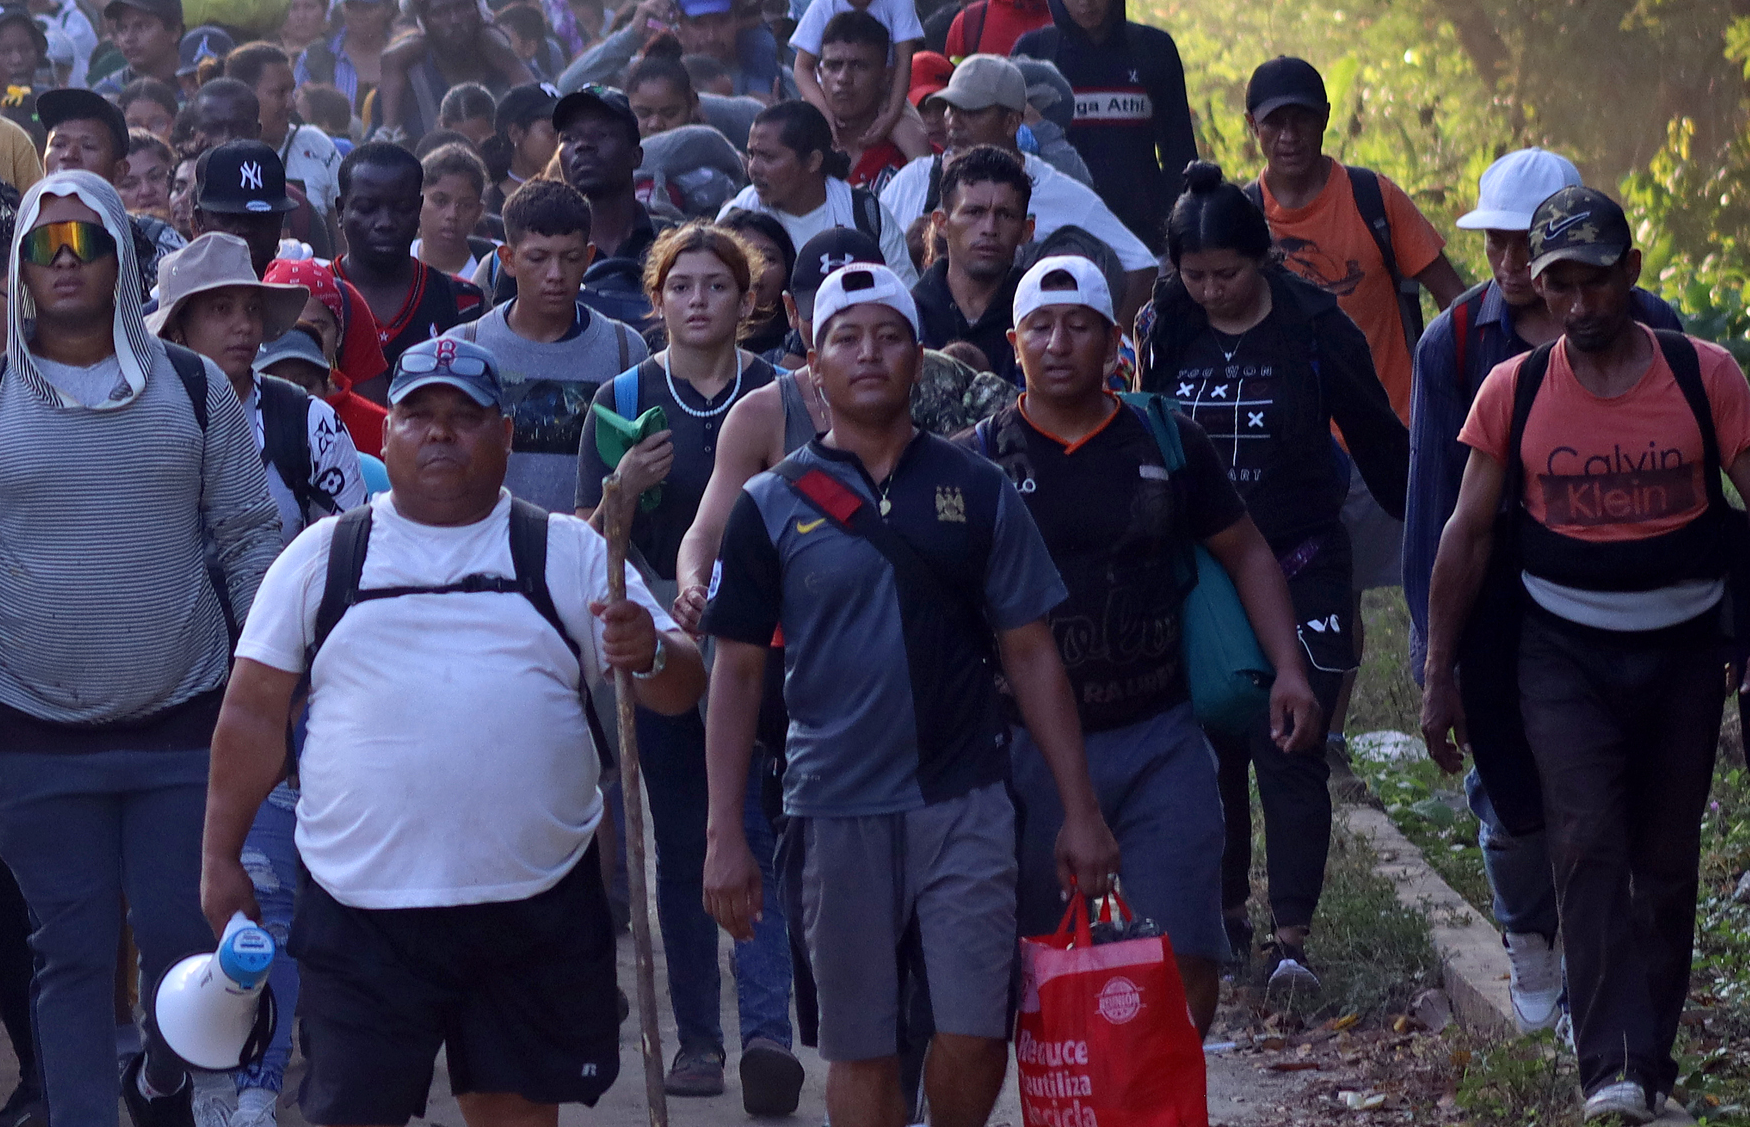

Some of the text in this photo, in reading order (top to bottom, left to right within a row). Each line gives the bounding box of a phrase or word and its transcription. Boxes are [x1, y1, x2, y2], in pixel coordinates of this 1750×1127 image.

[1076, 98, 1144, 115] ga Athl
[240, 160, 263, 190] NY
[437, 339, 456, 366] B
[1546, 441, 1683, 475] Calvin
[1567, 479, 1668, 519] Klein
